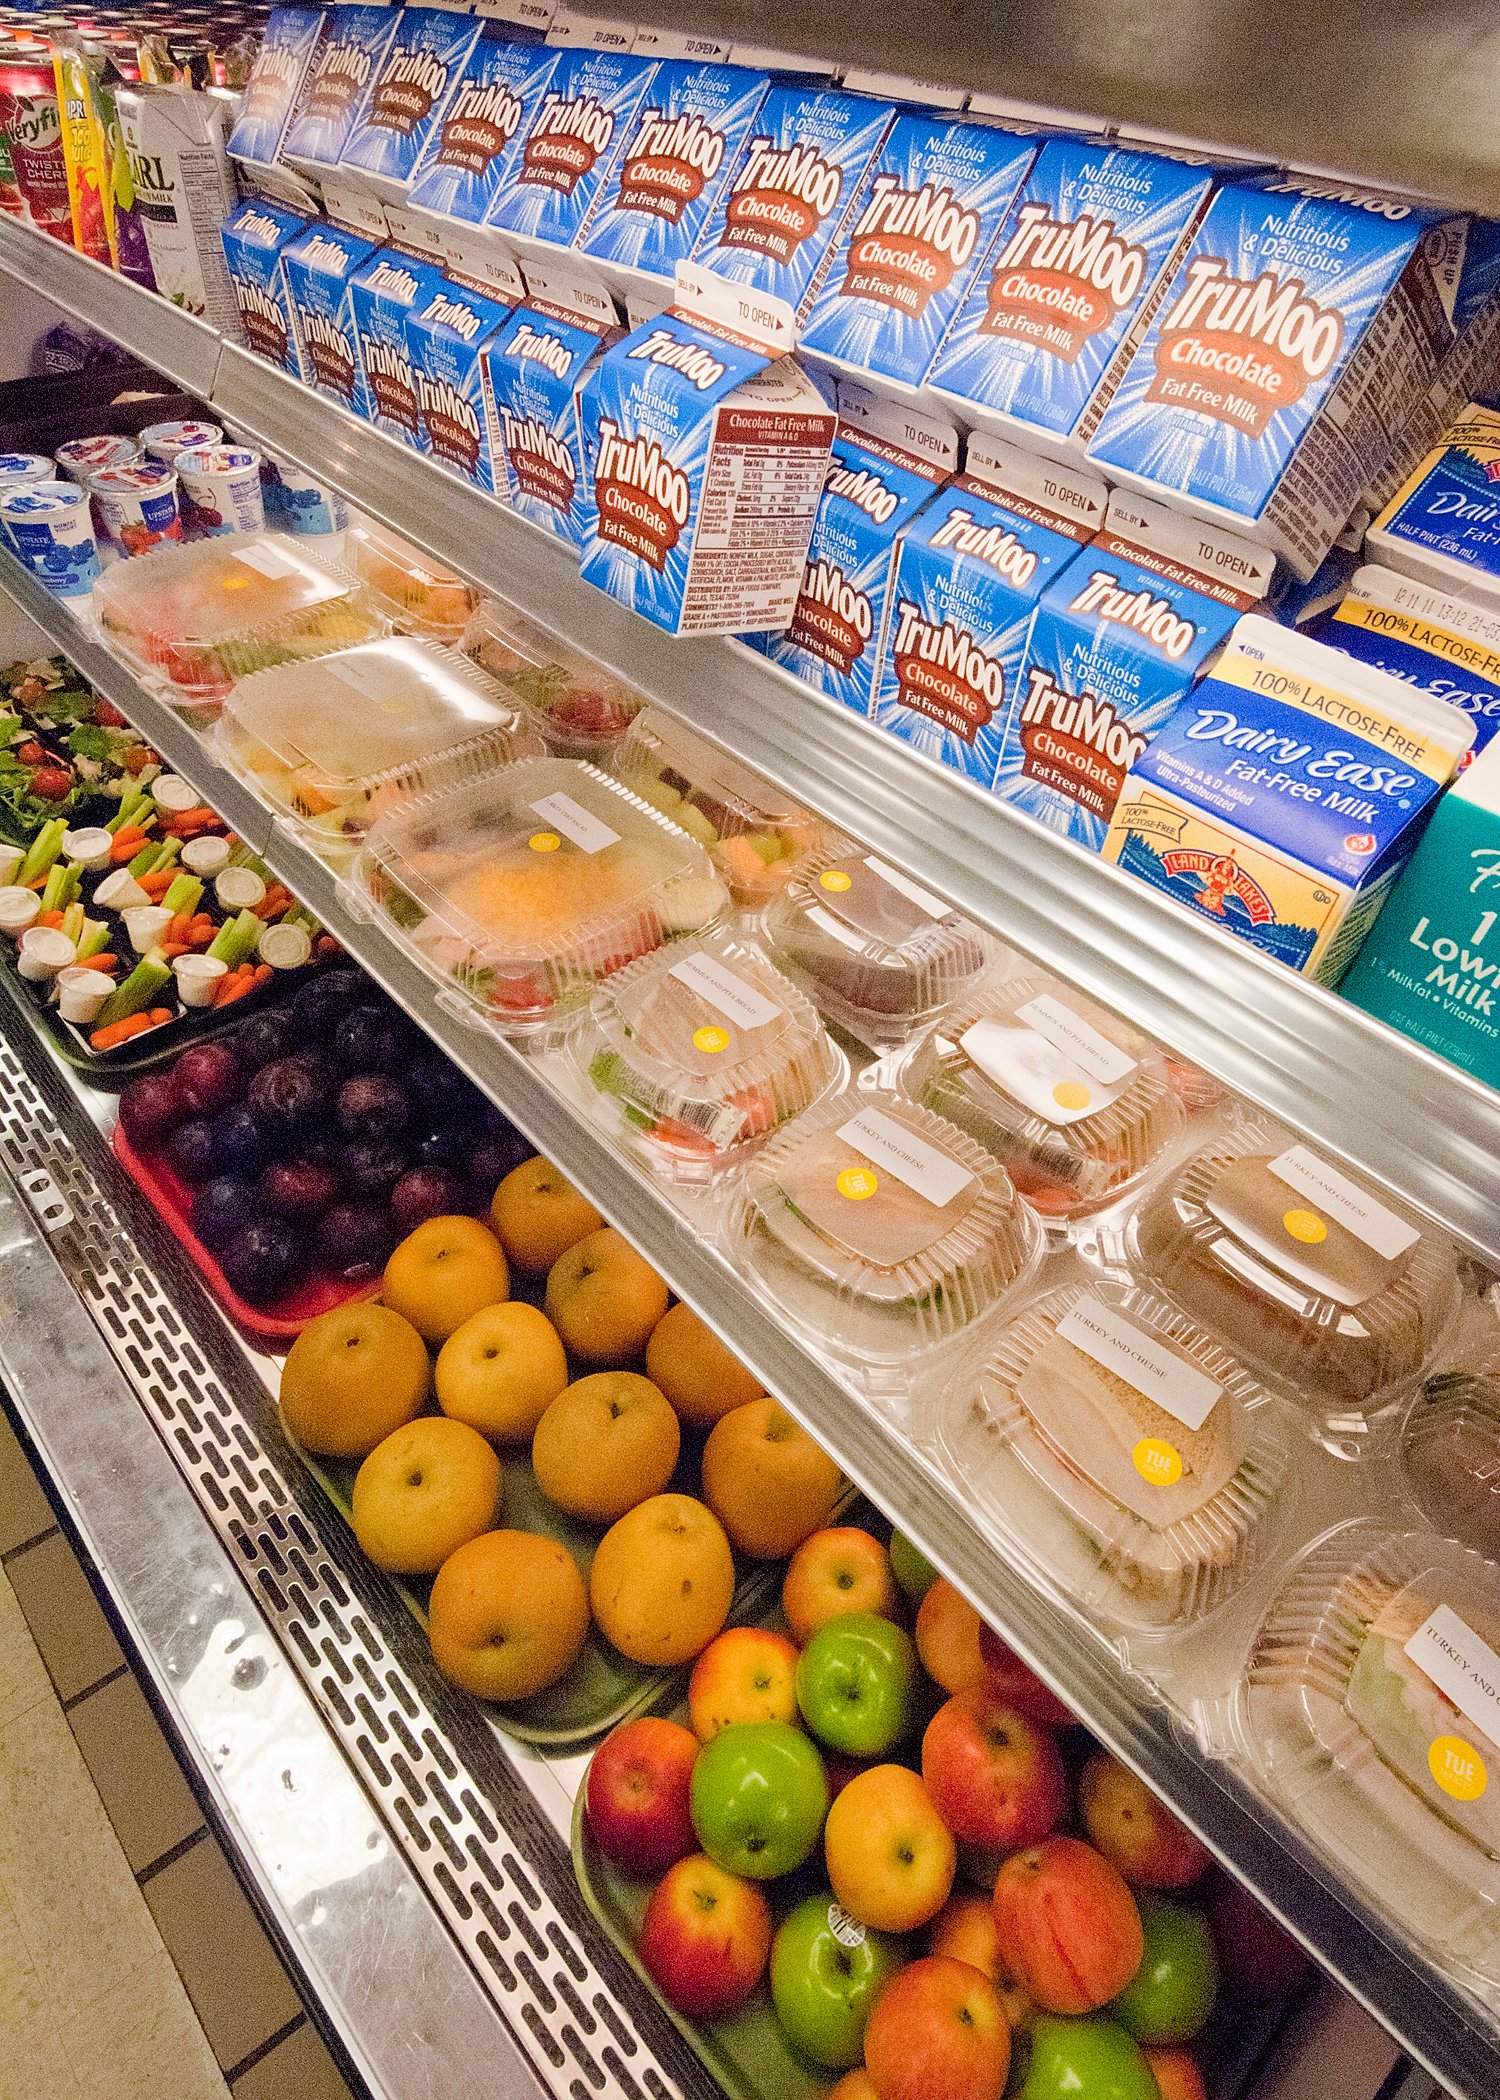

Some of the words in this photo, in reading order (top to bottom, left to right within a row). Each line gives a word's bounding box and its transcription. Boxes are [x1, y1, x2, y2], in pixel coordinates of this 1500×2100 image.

[317, 42, 371, 87] TruMoo
[379, 47, 448, 100] TruMoo
[683, 75, 731, 94] Nutritious
[380, 88, 423, 112] Chocolate
[448, 81, 521, 137] TruMoo
[797, 101, 851, 124] Nutritious
[4, 106, 60, 145] Veryfi
[449, 125, 496, 150] Chocolate
[531, 93, 613, 154] TruMoo
[628, 110, 723, 178] TruMoo
[796, 117, 846, 140] Delicious
[532, 141, 585, 167] Chocolate
[924, 153, 981, 181] Delicious
[925, 136, 987, 163] Nutritious
[630, 163, 692, 193] Chocolate
[733, 139, 840, 216] TruMoo
[1079, 163, 1152, 195] Nutritious
[152, 194, 173, 203] MILK
[737, 196, 805, 231] Chocolate
[1077, 182, 1146, 215] Delicious
[233, 210, 281, 246] TruMoo
[744, 230, 766, 248] Free
[767, 234, 788, 254] Milk
[854, 177, 976, 266] TruMoo
[1260, 214, 1350, 253] Nutritious
[301, 235, 349, 276] TruMoo
[859, 241, 937, 281] Chocolate
[997, 206, 1143, 305] TruMoo
[1259, 235, 1344, 275] Delicious
[365, 262, 419, 303] TruMoo
[868, 279, 894, 299] Free
[896, 284, 919, 309] Milk
[1001, 276, 1093, 323] Chocolate
[233, 274, 287, 333] TruMoo
[420, 294, 480, 341] TruMoo
[752, 308, 775, 328] OPEN
[1163, 262, 1338, 376] TruMoo
[298, 305, 354, 367] TruMoo
[505, 325, 573, 379] TruMoo
[991, 312, 1011, 332] Fat
[1013, 317, 1042, 339] Free
[1044, 323, 1073, 351] Milk
[628, 331, 726, 391] TruMoo
[1170, 337, 1283, 393] Chocolate
[416, 371, 480, 441] TruMoo
[629, 383, 679, 416] Nutritious
[1160, 378, 1184, 400] Fat
[1186, 383, 1222, 408] Free
[1223, 390, 1260, 425] Milk
[430, 417, 473, 450] Chocolate
[633, 405, 679, 438] Delicious
[730, 414, 773, 429] Chocolate
[788, 419, 806, 431] Free
[807, 420, 824, 432] Milk
[758, 431, 783, 440] VITAMIN
[841, 429, 883, 454] Chocolate
[500, 407, 575, 481] TruMoo
[712, 456, 731, 467] Facts
[714, 444, 744, 456] Nutrition
[917, 433, 941, 452] OPEN
[516, 455, 566, 490] Chocolate
[599, 421, 688, 524] TruMoo
[147, 506, 175, 520] UPSTATE
[606, 489, 668, 536] Chocolate
[967, 482, 1015, 512] Chocolate
[1030, 507, 1056, 528] Free
[1055, 517, 1078, 537] Milk
[1044, 480, 1057, 494] TO
[1060, 488, 1086, 510] OPEN
[619, 526, 637, 548] Free
[638, 536, 659, 562] Milk
[929, 510, 1036, 586] TruMoo
[1199, 542, 1213, 560] TO
[1216, 551, 1249, 577] OPEN
[1397, 521, 1420, 536] HALF
[1419, 530, 1441, 545] PINT
[1438, 539, 1460, 553] (236
[1459, 548, 1478, 561] mL)
[1110, 541, 1164, 573] Chocolate
[1164, 563, 1181, 580] Fat
[1181, 570, 1210, 594] Free
[1209, 582, 1239, 606] Milk
[935, 576, 994, 614] Nutritious
[940, 594, 993, 632] Delicious
[1069, 572, 1193, 658] TruMoo
[1363, 609, 1409, 631] 100%
[825, 644, 846, 667] Milk
[895, 602, 1003, 707] TruMoo
[1073, 644, 1142, 688] Nutritious
[1245, 645, 1264, 661] OPEN
[906, 664, 977, 715] Chocolate
[1078, 664, 1140, 707] Delicious
[905, 690, 921, 706] Fat
[922, 697, 944, 718] Free
[945, 710, 969, 735] Milk
[1022, 670, 1148, 769] TruMoo
[1251, 669, 1301, 697] 100%
[1301, 685, 1426, 765] LACTOSE-FREE
[1033, 732, 1118, 790] Chocolate
[1186, 708, 1301, 767] Dairy
[1307, 749, 1416, 798] Ease
[1032, 761, 1050, 780] Fat
[1050, 770, 1076, 793] Free
[1077, 781, 1106, 812] Milk
[1155, 749, 1197, 779] Vitamins
[1195, 769, 1203, 782] A
[1204, 774, 1213, 787] &
[1213, 777, 1222, 790] D
[1220, 781, 1254, 806] Added
[1156, 766, 1236, 813] Ultra-Pasteurized
[1227, 760, 1321, 803] Fat-Free
[1322, 790, 1380, 824] Milk
[1121, 816, 1177, 835] LACTOSE-FREE
[1126, 807, 1149, 816] 100%
[1172, 855, 1209, 870] LAND
[1234, 875, 1269, 914] LAKES
[683, 961, 709, 980] HUMMUS
[709, 979, 722, 990] AND
[722, 987, 736, 1000] PITA
[735, 998, 757, 1015] BREAD
[1387, 969, 1431, 999] Milkfat
[1443, 998, 1499, 1038] Vitamins
[1425, 964, 1497, 1016] Milk
[1030, 1003, 1058, 1025] HUMMUS
[1058, 1023, 1072, 1035] AND
[1071, 1033, 1086, 1049] PITA
[1086, 1046, 1110, 1065] BREAD
[1405, 1019, 1425, 1036] HALF
[853, 1120, 881, 1142] TURKEY
[880, 1139, 898, 1153] AND
[897, 1150, 926, 1171] CHEESE
[851, 1174, 868, 1192] TUE
[1285, 1156, 1317, 1181] TURKEY
[1316, 1180, 1336, 1195] AND
[1335, 1193, 1368, 1219] CHEESE
[1073, 1311, 1111, 1339] TURKEY
[1109, 1336, 1131, 1354] AND
[1131, 1351, 1168, 1380] CHEESE
[1146, 1450, 1173, 1473] TUE
[1425, 1625, 1472, 1671] TURKEY
[1470, 1672, 1496, 1697] AND
[1445, 1750, 1475, 1782] TUE
